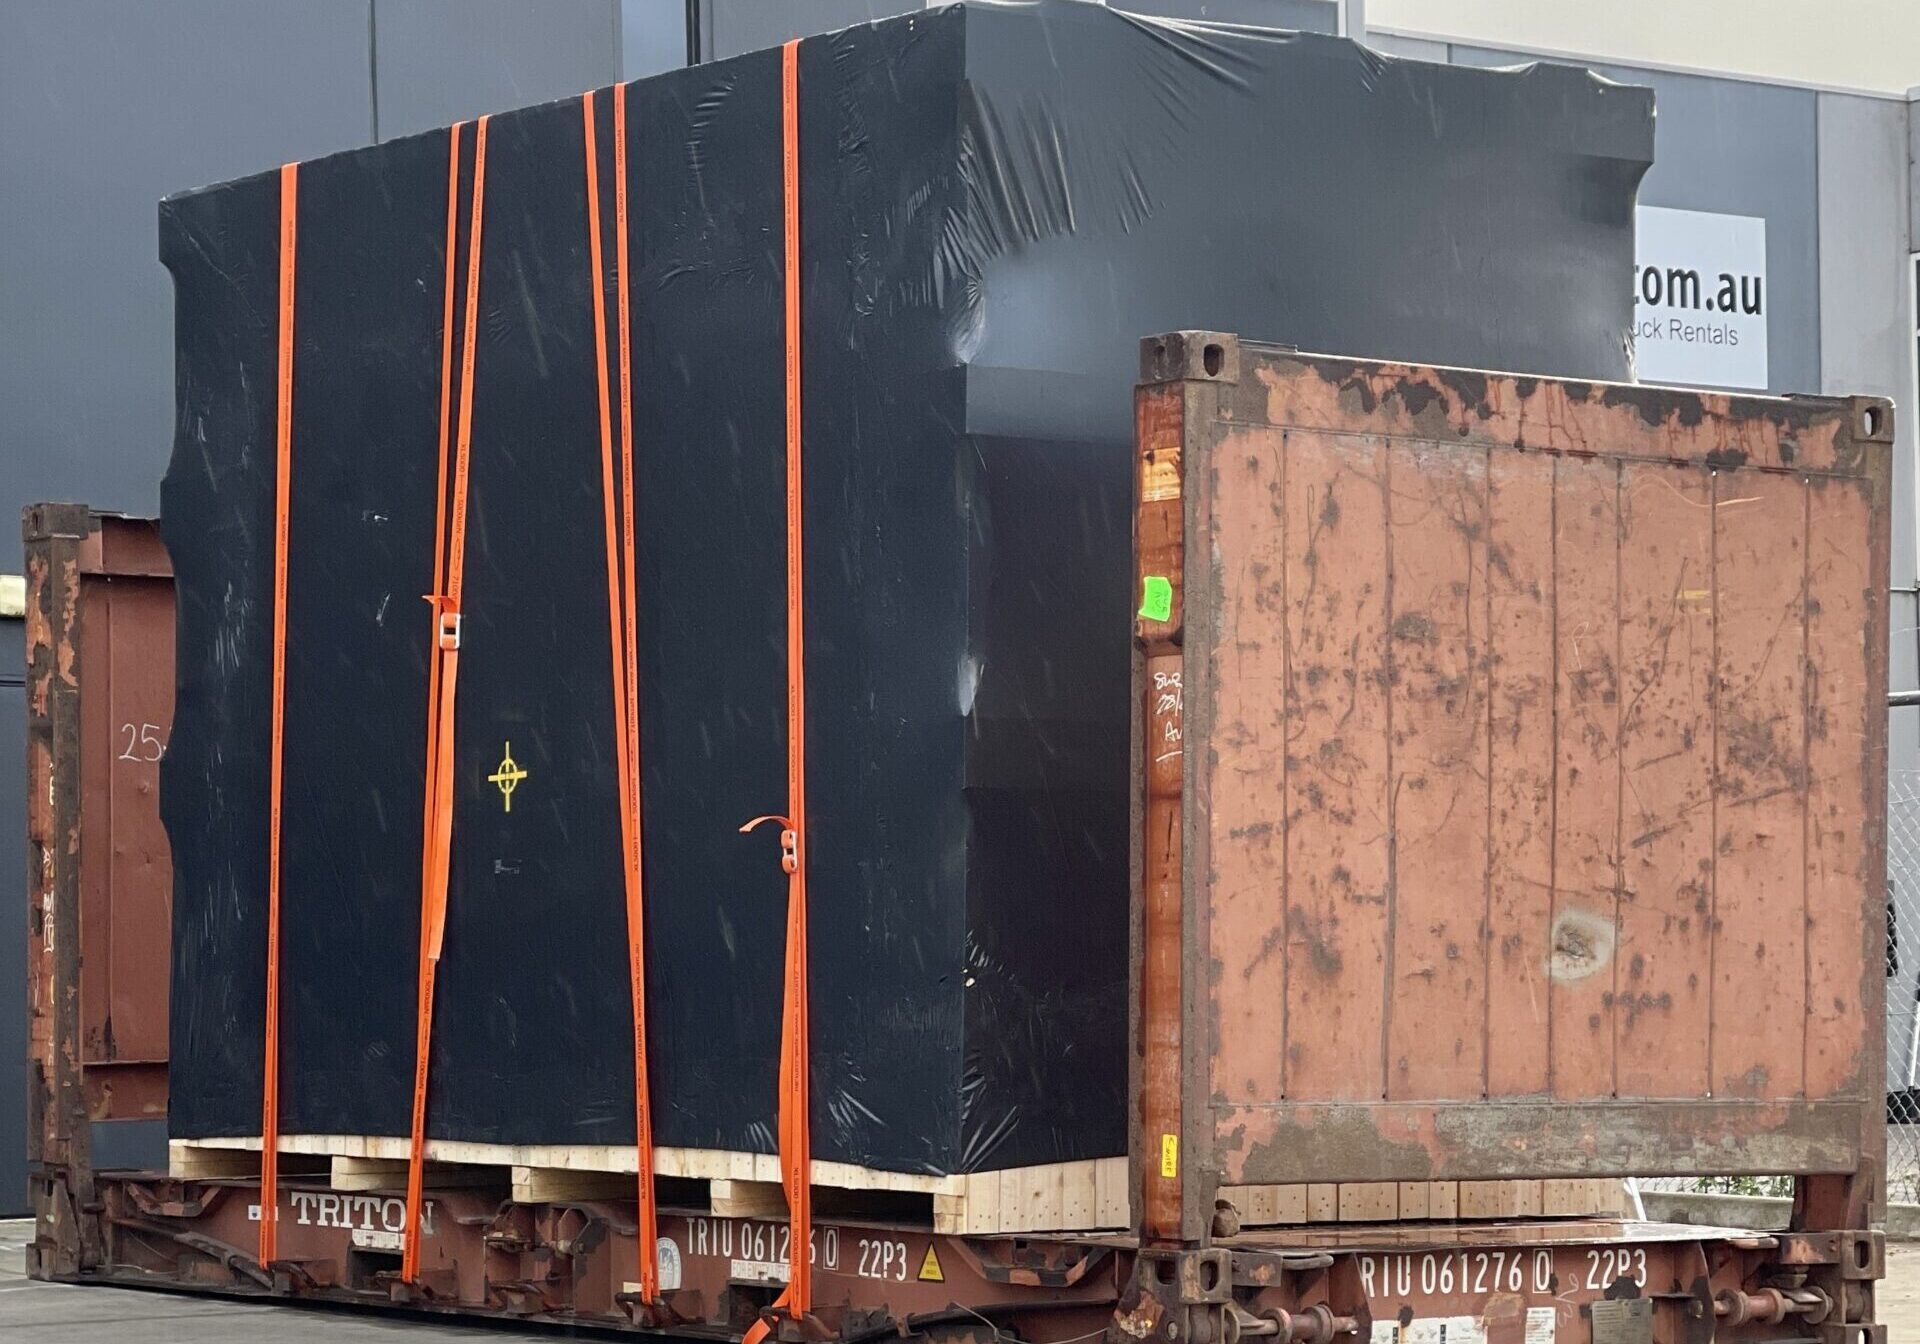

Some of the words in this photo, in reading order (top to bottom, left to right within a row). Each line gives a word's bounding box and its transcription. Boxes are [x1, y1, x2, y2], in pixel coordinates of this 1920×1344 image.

[1633, 264, 1763, 316] om.au
[1669, 318, 1739, 346] Rentals
[118, 723, 169, 762] 25
[290, 1191, 435, 1237] TRITON
[686, 1217, 733, 1258] TRIU
[740, 1222, 817, 1265] 06126
[858, 1239, 908, 1281] 22P3
[1421, 1251, 1523, 1294] 061276
[1534, 1249, 1552, 1292] 0
[1585, 1248, 1648, 1290] 22P3
